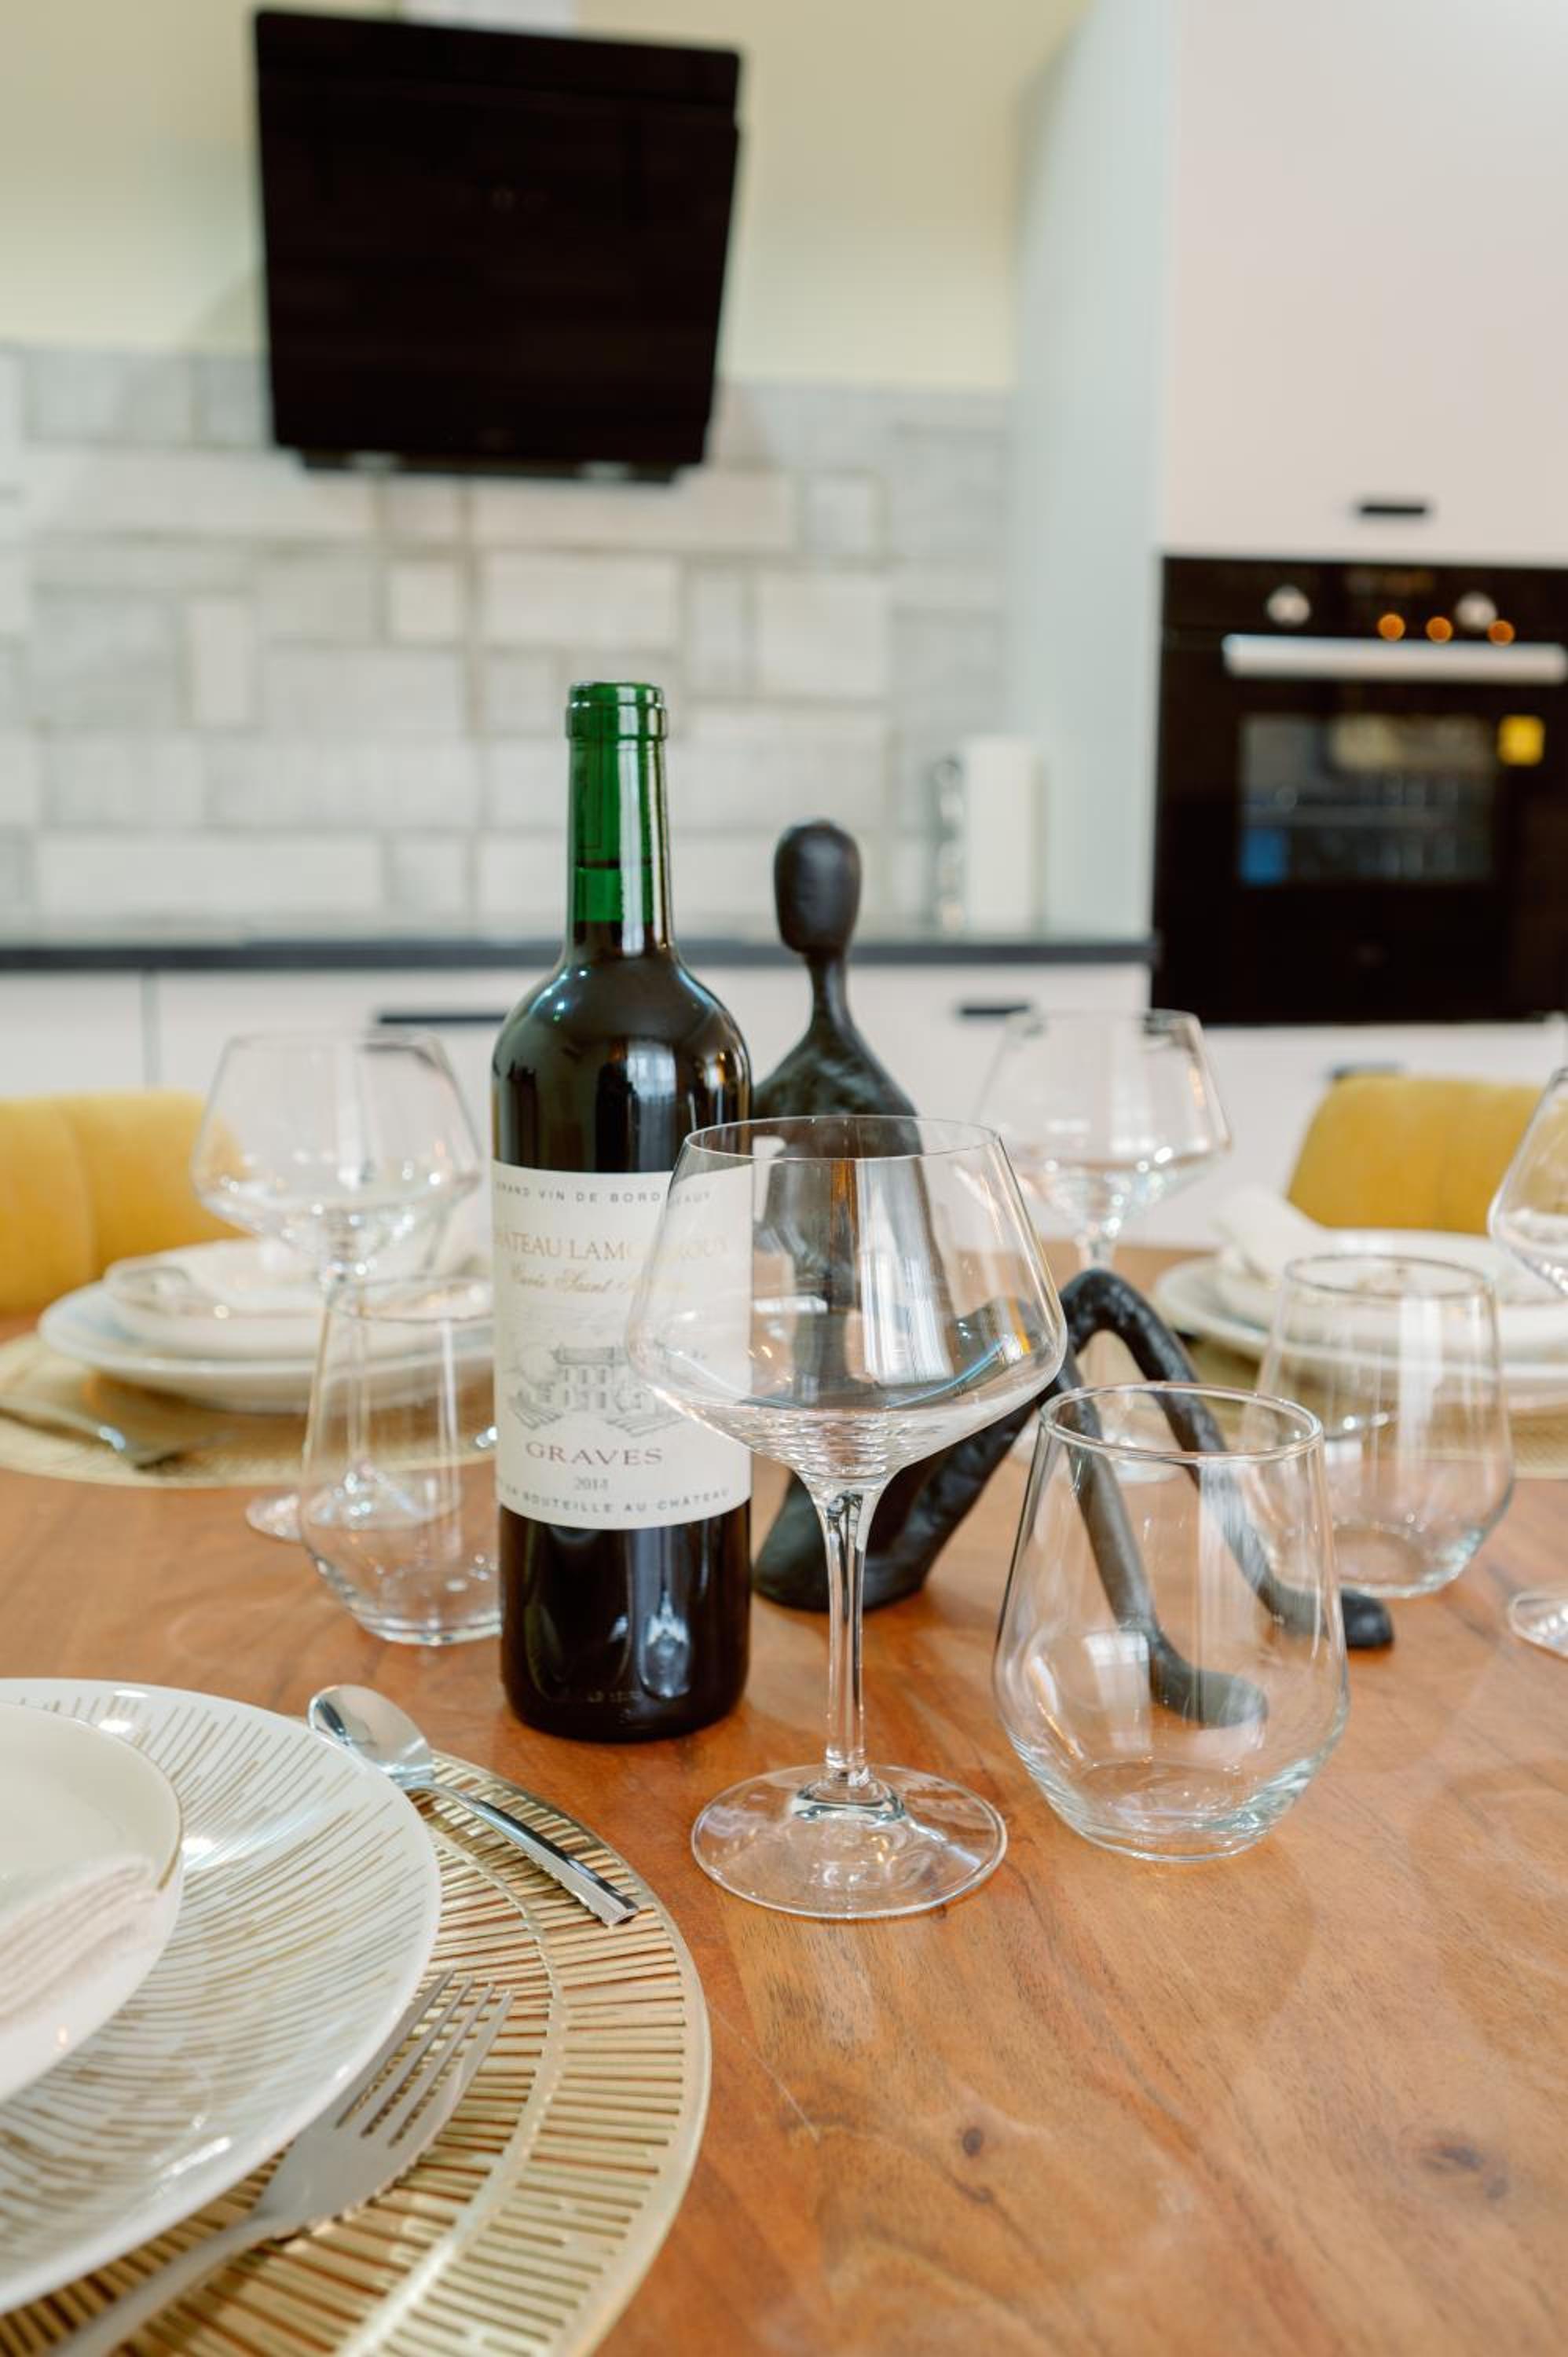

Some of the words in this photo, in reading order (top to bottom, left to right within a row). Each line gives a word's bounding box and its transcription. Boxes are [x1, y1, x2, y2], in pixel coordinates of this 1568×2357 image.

[539, 1189, 565, 1201] VIN
[576, 1191, 598, 1203] DE
[526, 1441, 664, 1466] GRAVES
[624, 1502, 647, 1513] AU
